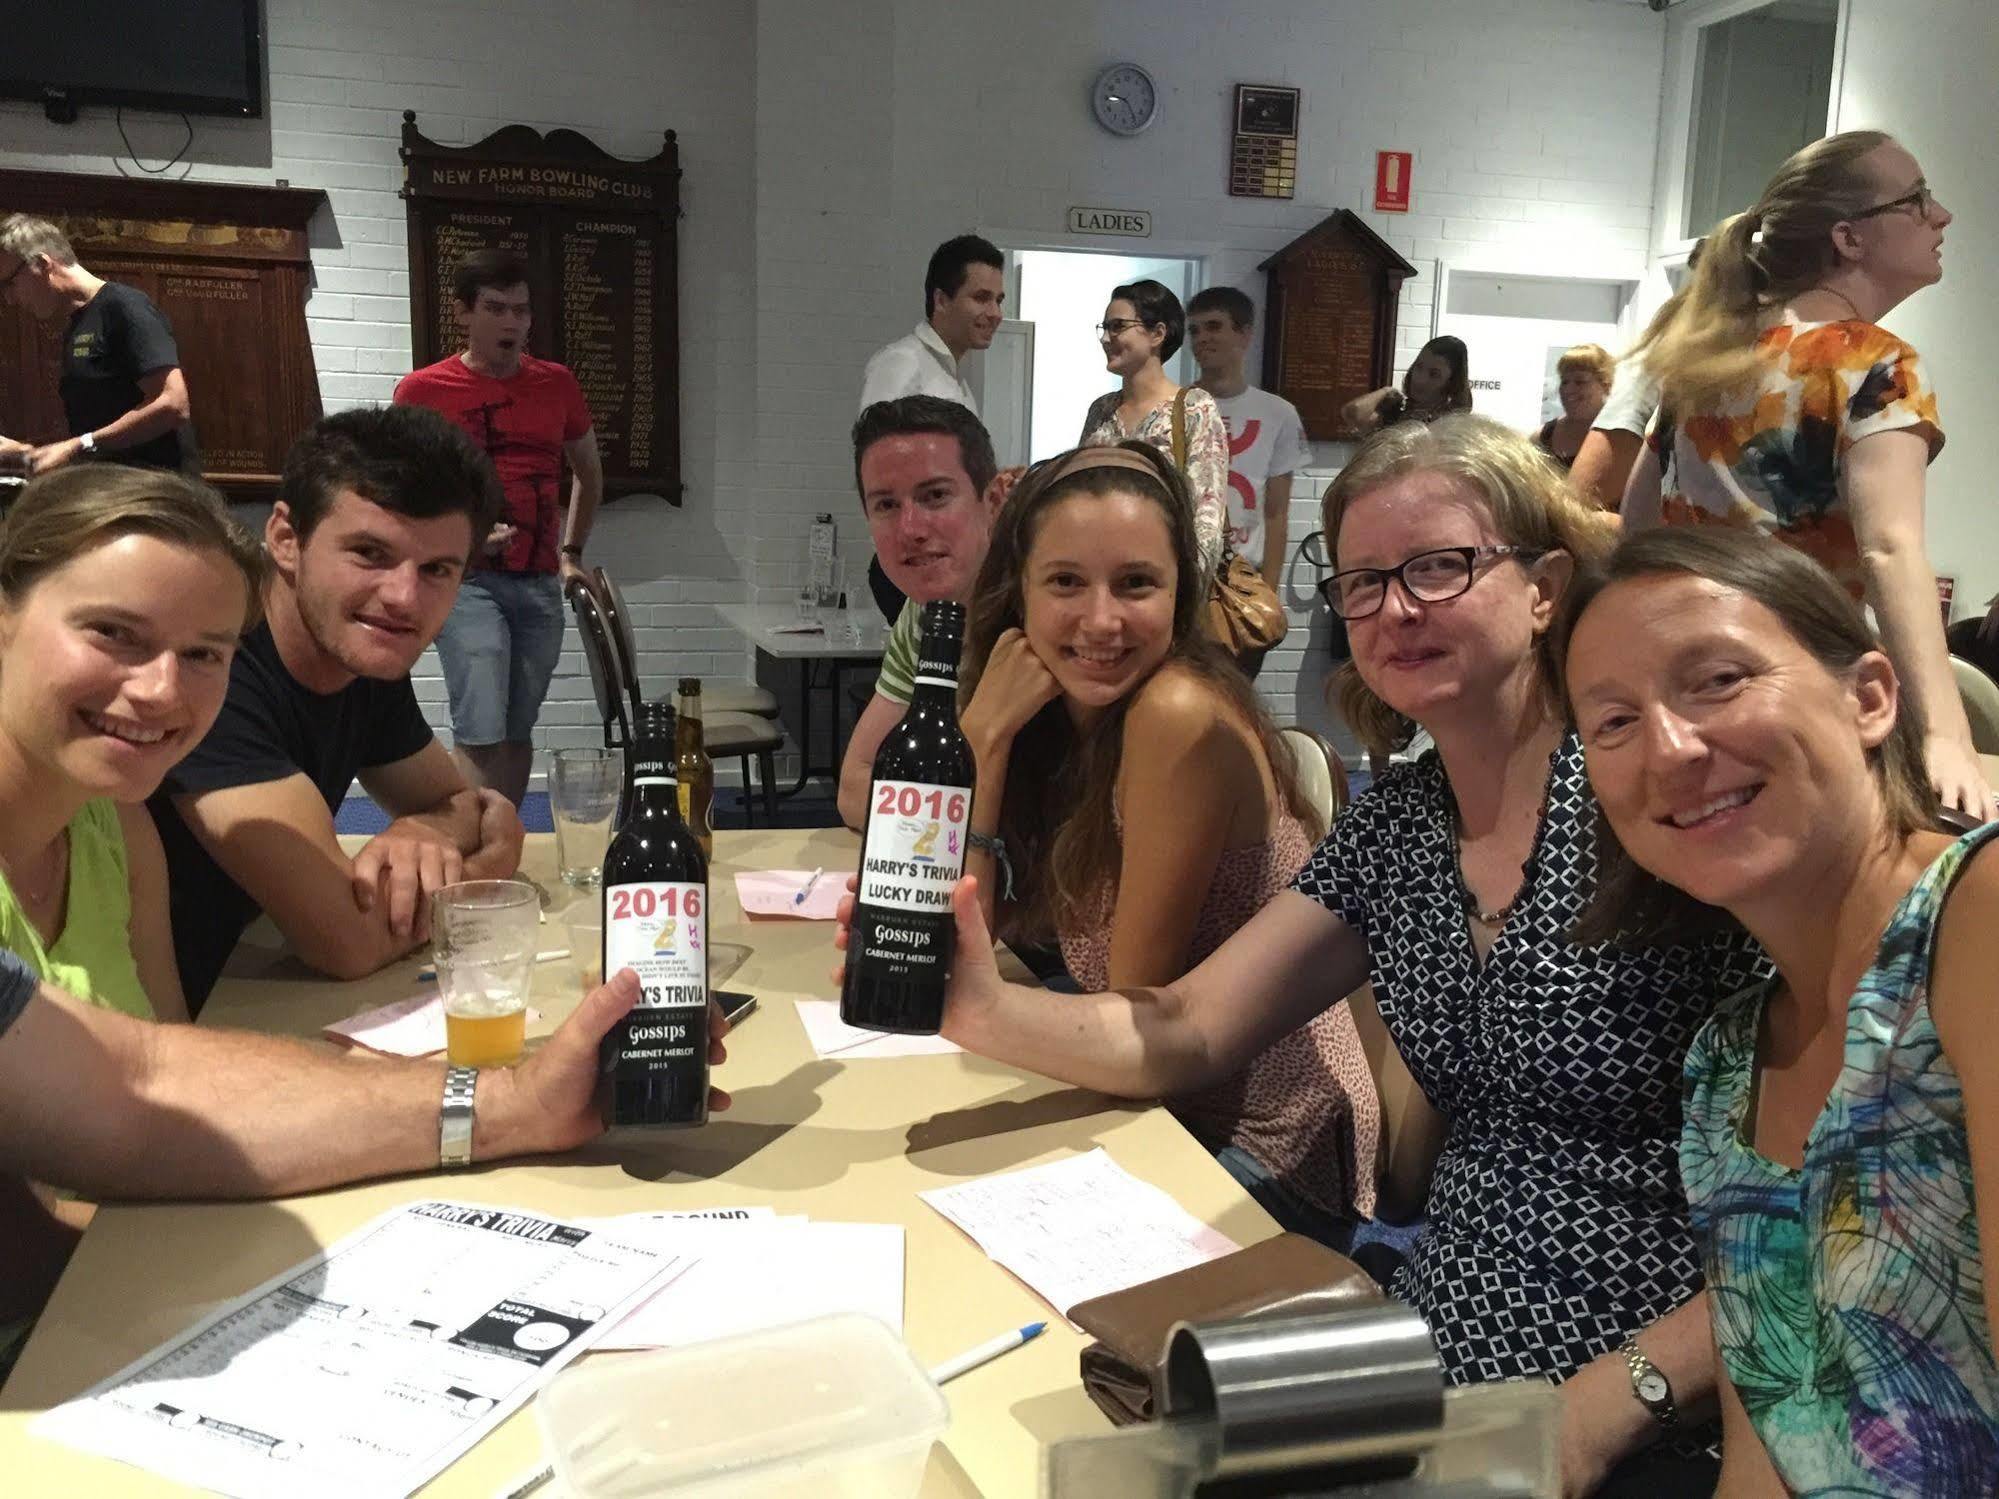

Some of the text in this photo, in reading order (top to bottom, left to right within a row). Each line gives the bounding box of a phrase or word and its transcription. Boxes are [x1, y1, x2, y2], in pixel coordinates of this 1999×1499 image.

[432, 167, 654, 200] NEW FARM BOWLING CLUB
[494, 182, 596, 200] HONOR BOARD
[451, 214, 512, 225] PRESIDENT
[576, 222, 637, 235] CHAMPION
[1077, 212, 1144, 232] LADIES
[877, 785, 966, 824] 2016
[866, 857, 960, 881] HARRY'S TRIVIA
[612, 887, 702, 920] 2016
[868, 883, 951, 906] LUCKY DRAW
[865, 948, 937, 964] CABERNET MERLOT
[665, 985, 705, 1004] TRIVIA
[621, 1047, 695, 1060] CABERNET MERLOT
[491, 1213, 558, 1241] TRIVIA
